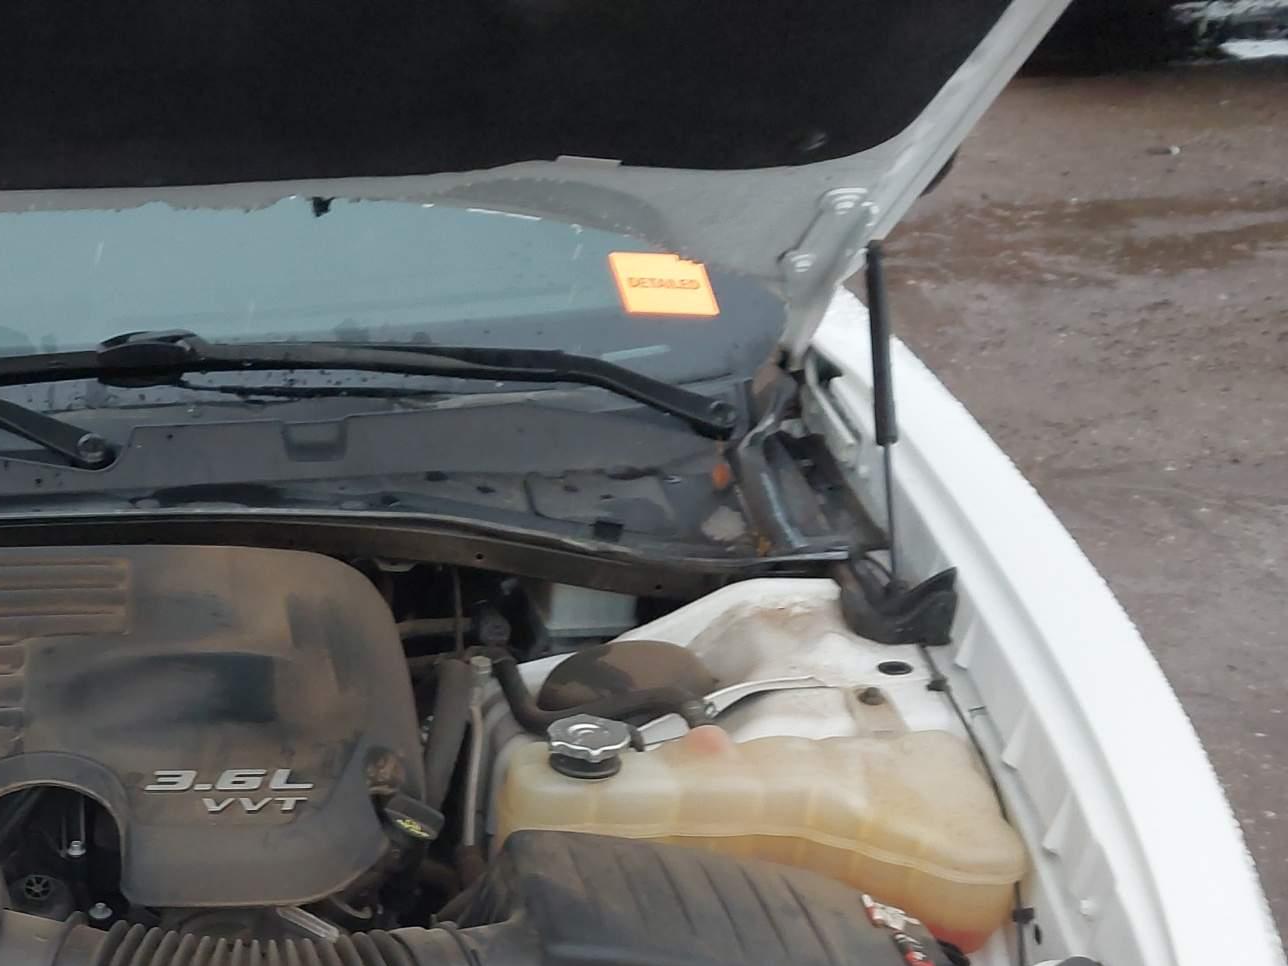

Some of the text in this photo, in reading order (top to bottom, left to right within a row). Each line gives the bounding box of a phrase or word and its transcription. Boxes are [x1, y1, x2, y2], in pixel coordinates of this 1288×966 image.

[627, 277, 701, 290] DETAILED
[143, 768, 315, 791] 3.6L
[201, 796, 309, 813] VVT
